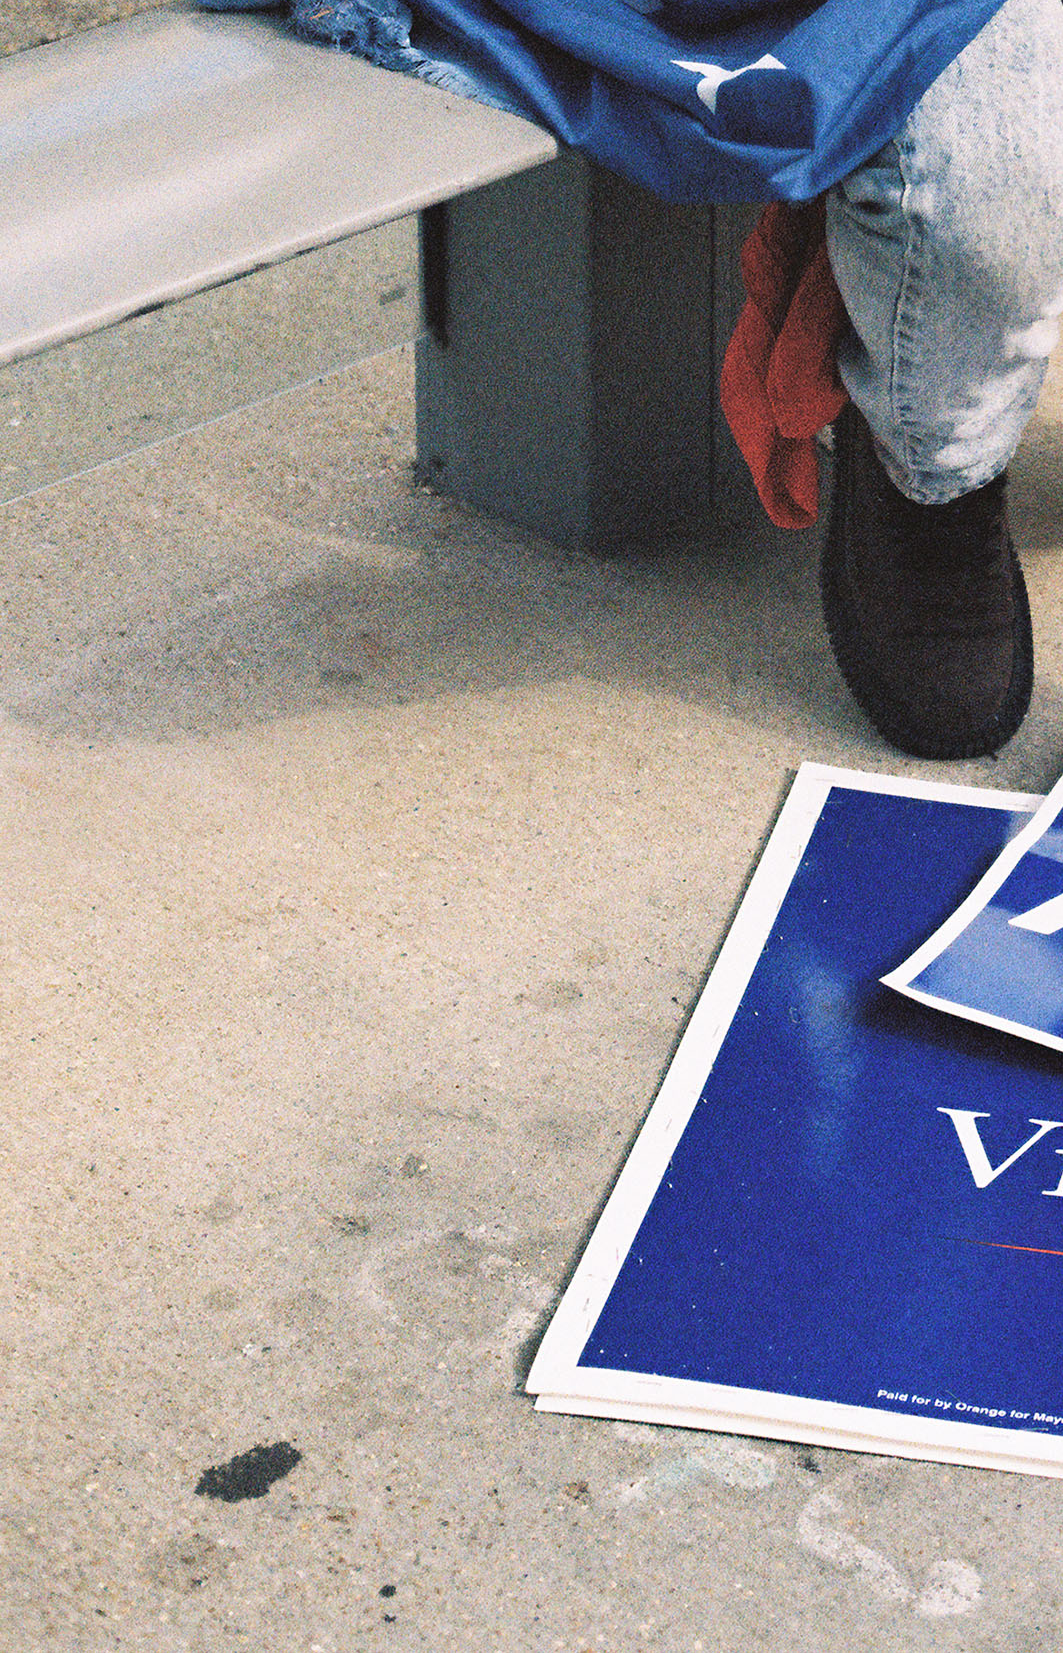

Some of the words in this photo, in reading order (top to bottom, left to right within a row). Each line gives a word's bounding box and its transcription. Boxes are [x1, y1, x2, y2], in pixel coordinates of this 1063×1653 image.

[877, 1389, 908, 1402] Paid
[911, 1394, 931, 1406] for
[934, 1398, 952, 1411] by
[955, 1402, 1007, 1418] Orange
[1010, 1409, 1030, 1421] for
